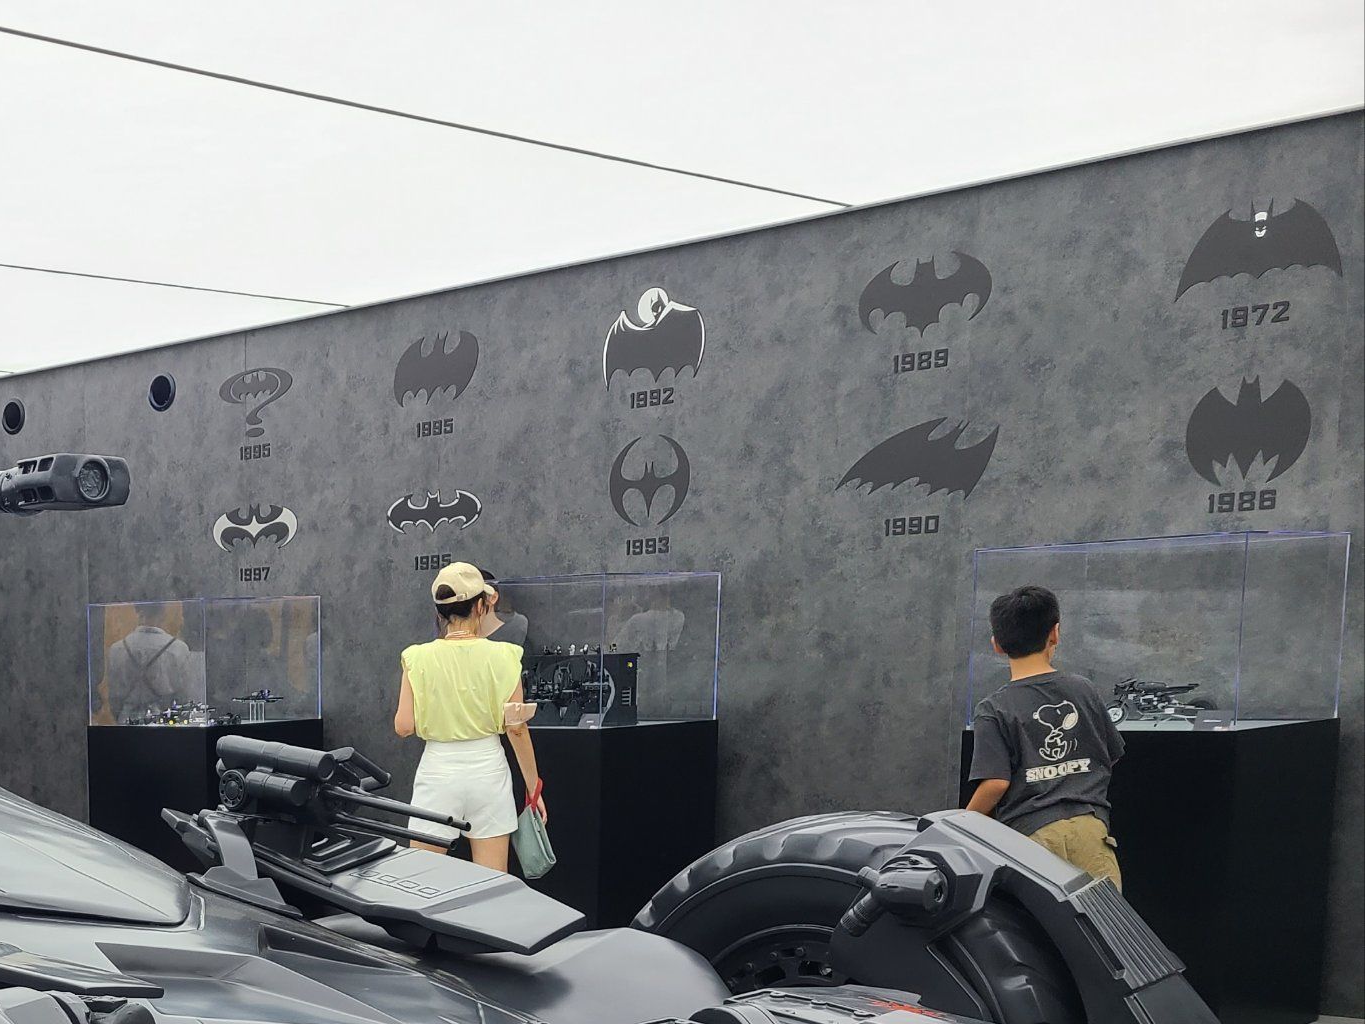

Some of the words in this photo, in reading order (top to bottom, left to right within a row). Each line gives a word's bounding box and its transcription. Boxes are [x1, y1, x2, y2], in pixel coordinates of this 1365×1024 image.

[1221, 301, 1290, 330] 1972
[893, 348, 949, 374] 1989
[630, 387, 675, 409] 1992
[416, 418, 454, 438] 1995
[239, 443, 271, 461] 1995
[1207, 490, 1277, 514] 1986
[884, 515, 940, 537] 1990
[625, 537, 670, 556] 1993
[414, 553, 452, 571] 1995
[240, 567, 270, 582] 1997
[1025, 758, 1091, 783] SNOOPY
